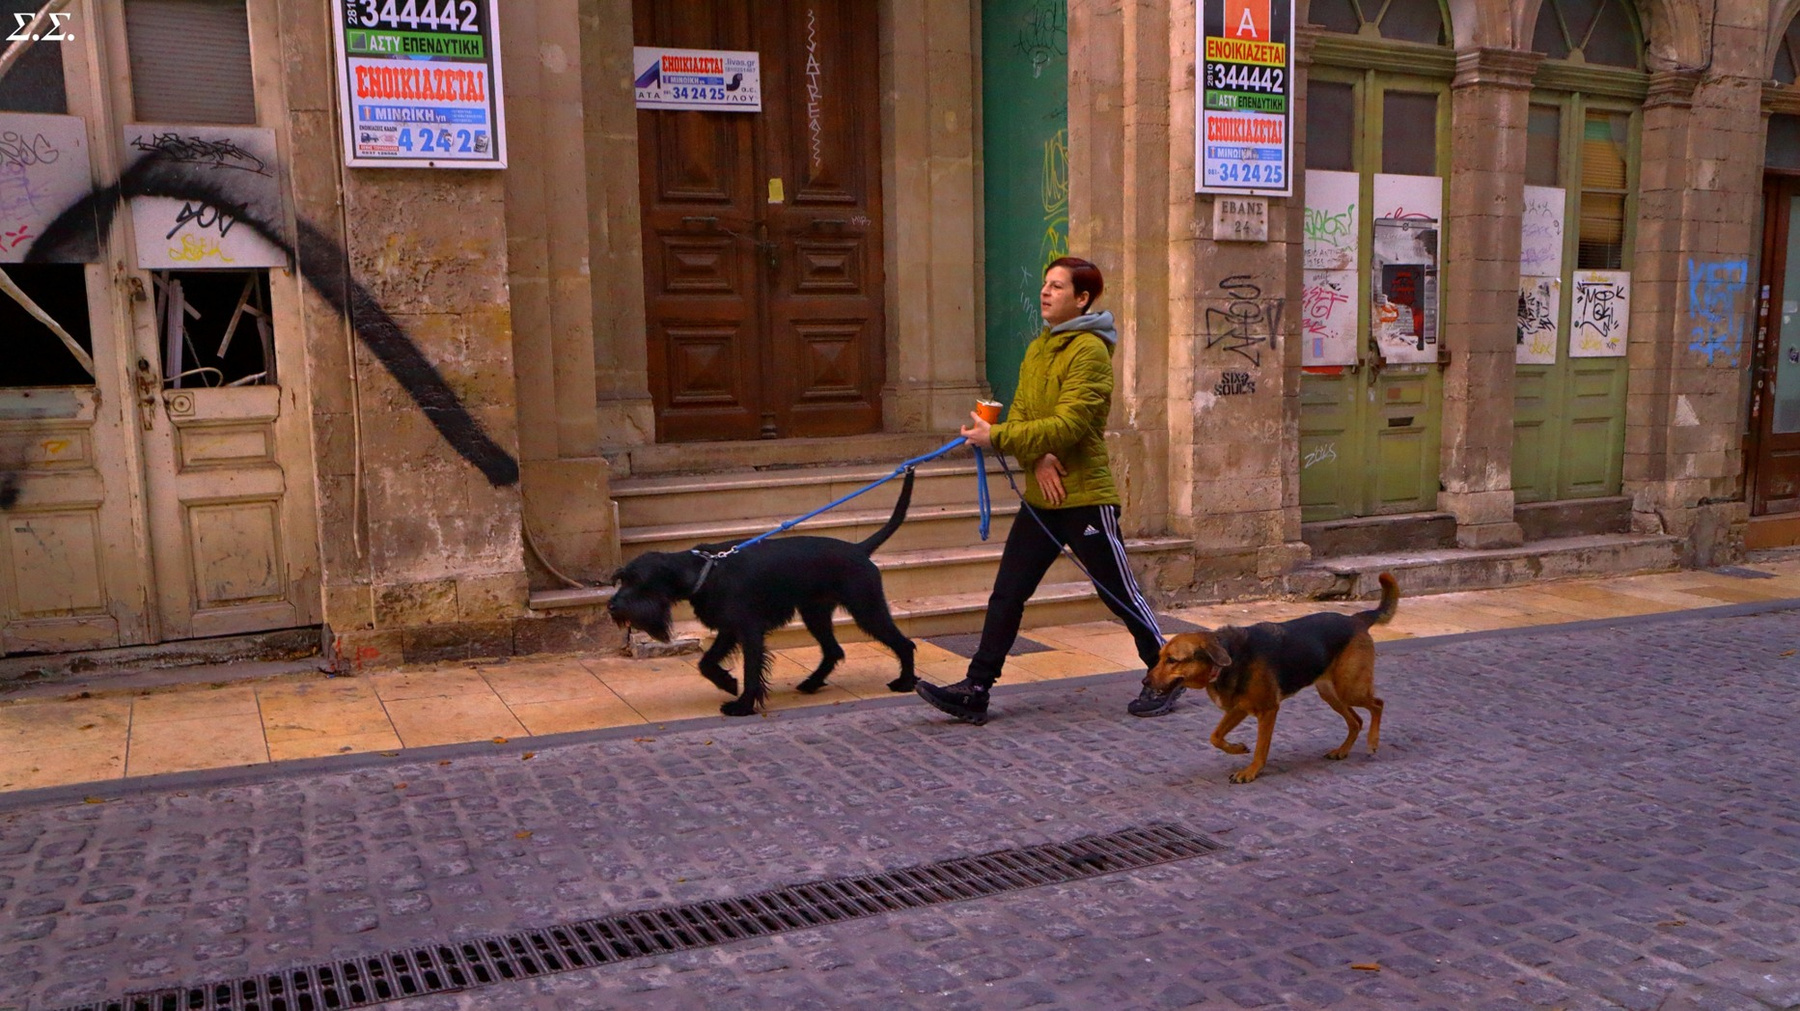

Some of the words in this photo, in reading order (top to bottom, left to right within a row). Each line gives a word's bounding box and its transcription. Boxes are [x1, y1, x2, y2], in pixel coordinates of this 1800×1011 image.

[359, 0, 479, 32] 344442
[369, 35, 401, 52] ΑΣΤΥ
[402, 37, 480, 55] ΕΠΕΝΔΥΤΙΚΗ
[1207, 40, 1285, 64] ΕΝΟΙΚΙΑΖΕΤΑΙ
[662, 55, 724, 74] ΕΝΟΙΚΙΑΖΕΤΑΙ
[355, 65, 485, 103] ΕΝΟΙΚΙΑΖΕΤΑΙ
[1215, 63, 1284, 93] 344442
[673, 87, 688, 99] 34
[691, 87, 707, 100] 24
[709, 88, 725, 100] 25
[1218, 94, 1237, 108] ΑΣΤΥ
[1238, 96, 1283, 111] ΕΠΕΝΔΥΤΙΚΗ
[398, 128, 413, 152] 4
[419, 128, 451, 152] 24
[1207, 116, 1283, 144] ΕΝΟΙΚΙΑΖΕΤΑΙ
[1217, 163, 1237, 182] 34
[1240, 163, 1259, 182] 24
[1262, 164, 1280, 183] 25
[1221, 201, 1263, 216] ΕΒΑΝΣ
[1234, 220, 1250, 233] 24
